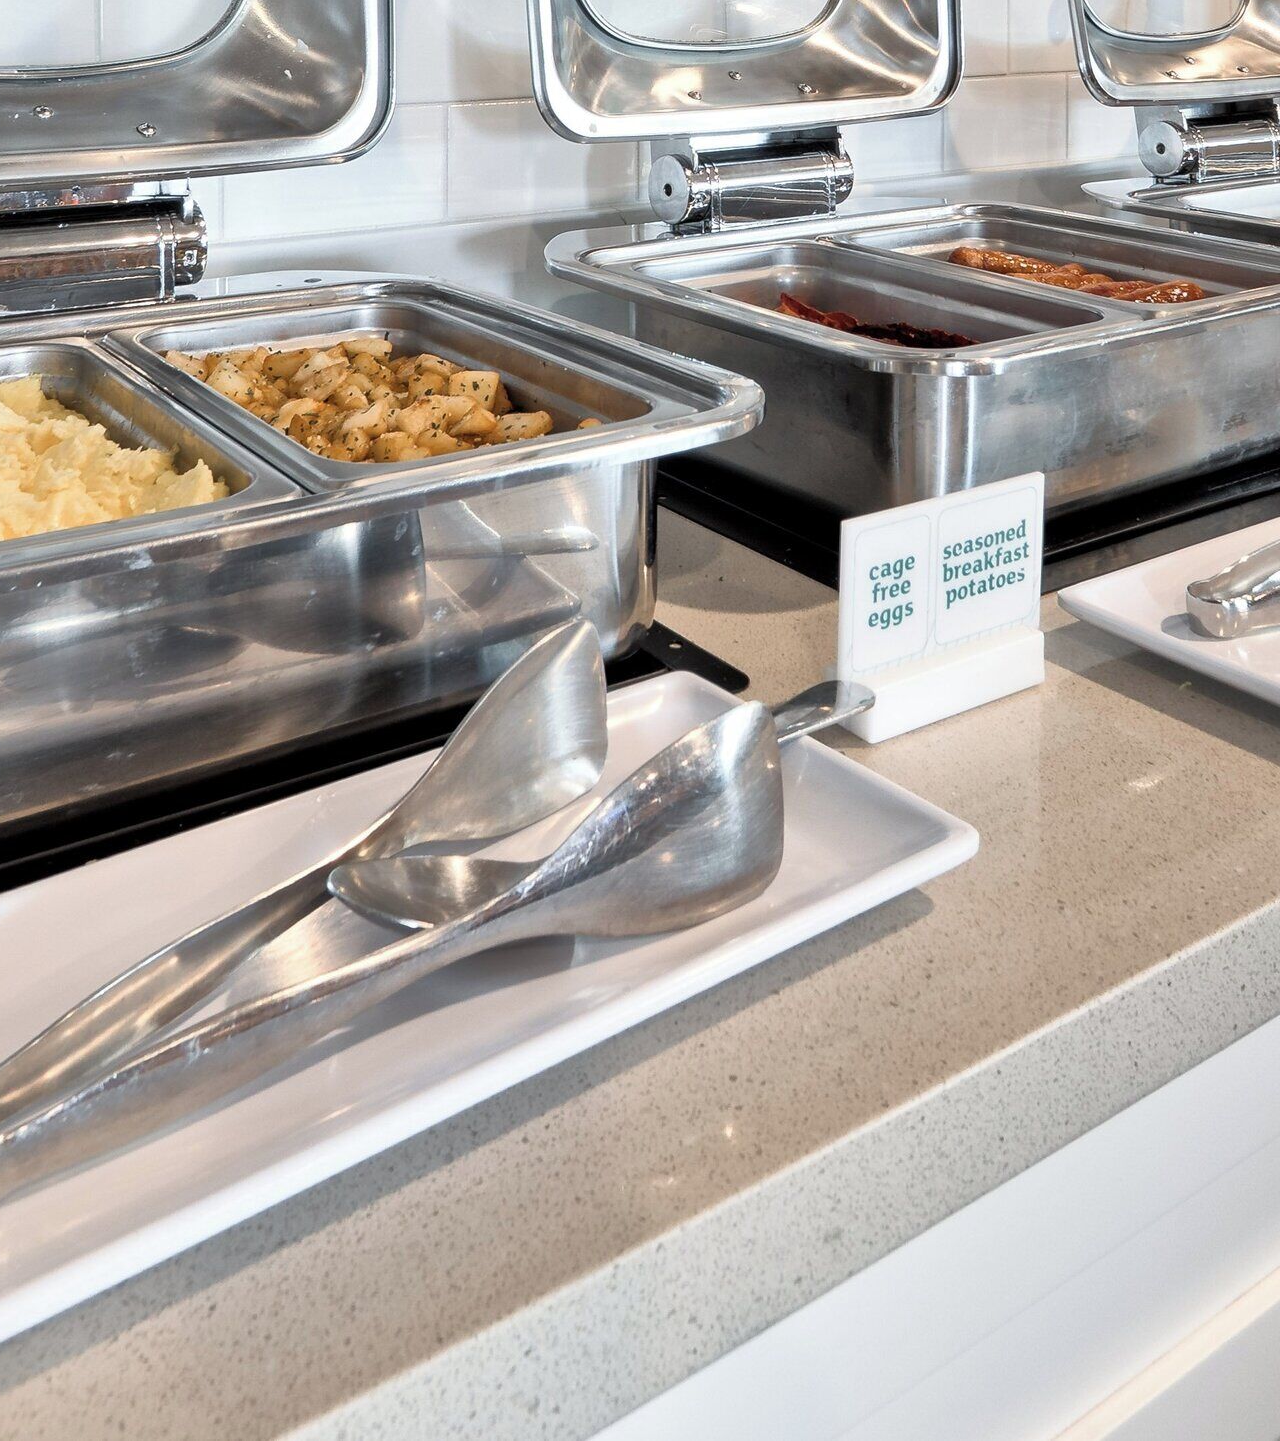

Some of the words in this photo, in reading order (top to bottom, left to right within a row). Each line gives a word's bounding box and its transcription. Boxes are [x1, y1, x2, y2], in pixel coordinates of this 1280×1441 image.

[943, 519, 1027, 560] seasoned
[869, 555, 915, 581] cage
[943, 542, 1029, 583] breakfast
[872, 579, 911, 604] free
[945, 567, 1026, 609] potatoes
[868, 601, 914, 630] eggs
